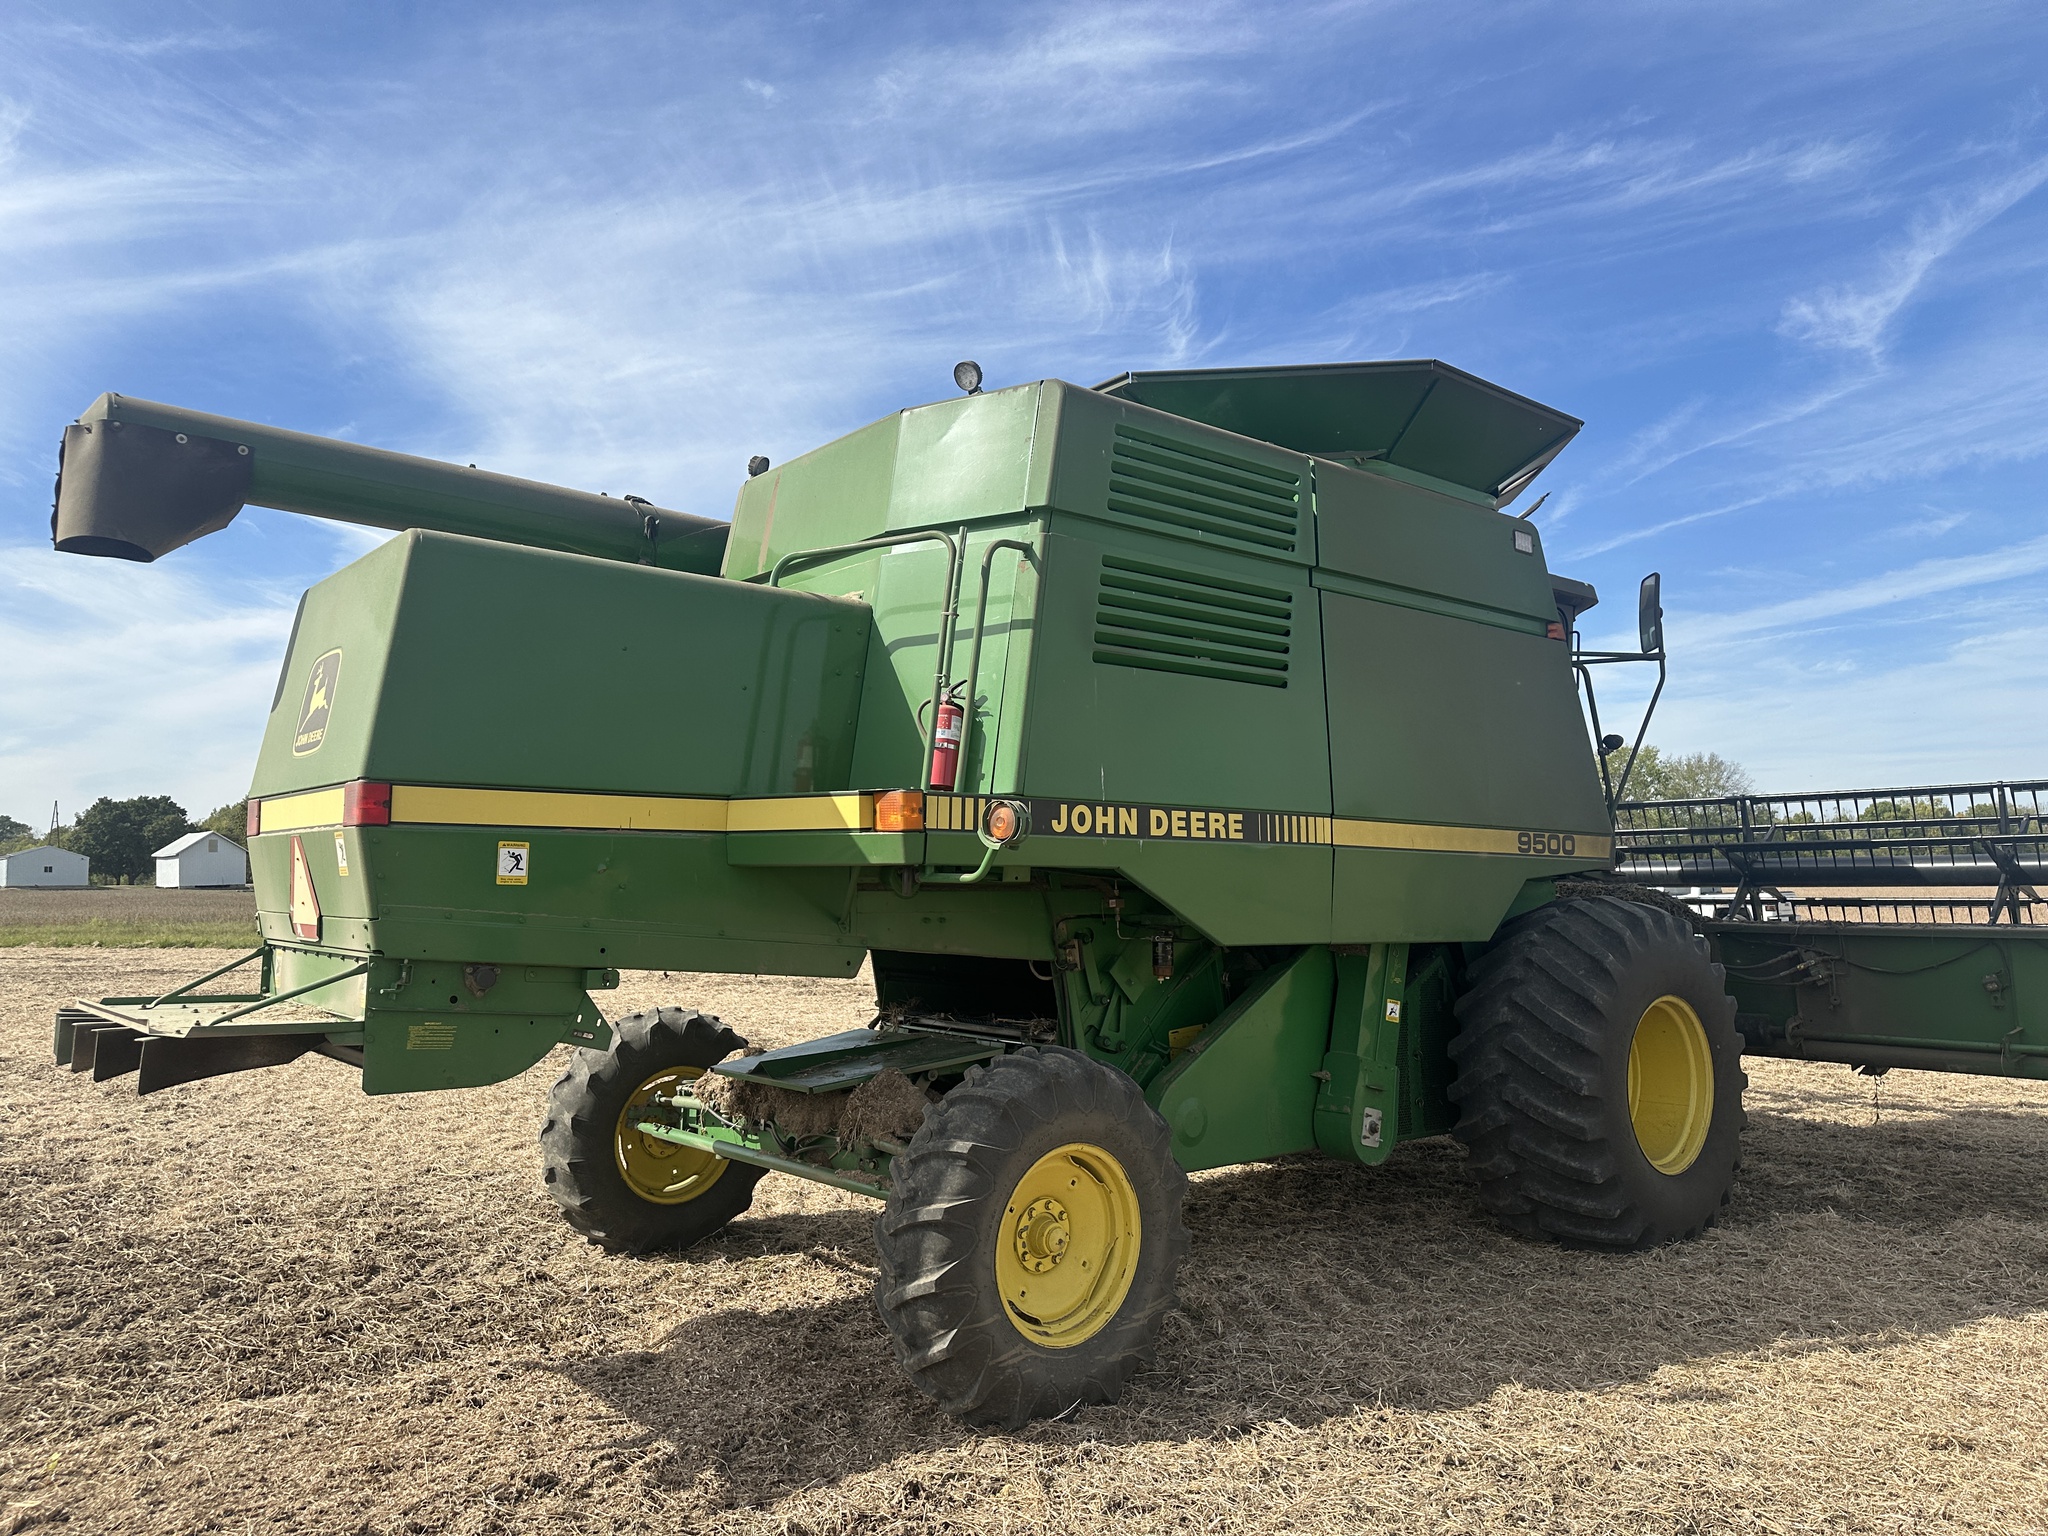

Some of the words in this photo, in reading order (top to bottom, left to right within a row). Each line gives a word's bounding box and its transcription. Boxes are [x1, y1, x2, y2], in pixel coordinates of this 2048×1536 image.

[296, 734, 308, 747] JOHN
[308, 729, 324, 742] DEERE
[1051, 804, 1138, 835] JOHN
[1150, 808, 1244, 840] DEERE
[1517, 832, 1576, 856] 9500
